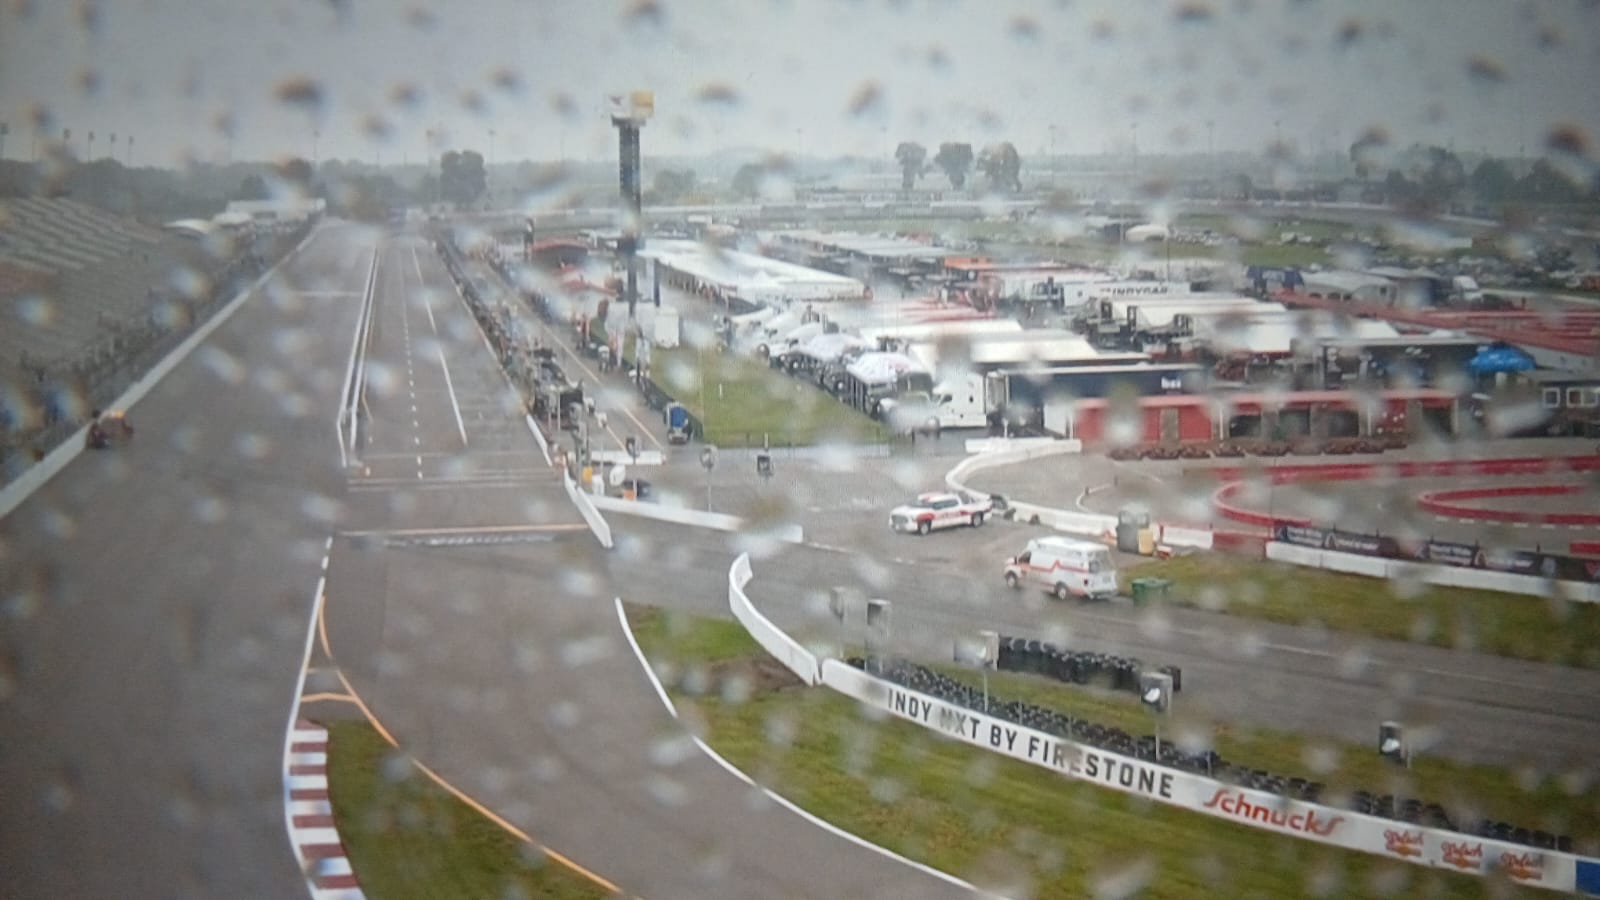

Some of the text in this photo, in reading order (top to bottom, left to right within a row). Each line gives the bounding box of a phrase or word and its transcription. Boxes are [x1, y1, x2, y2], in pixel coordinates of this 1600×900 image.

[888, 688, 932, 723] INDY
[990, 723, 1017, 751] BY
[1028, 735, 1174, 799] FIRESTONE
[1203, 788, 1345, 837] Schnucks
